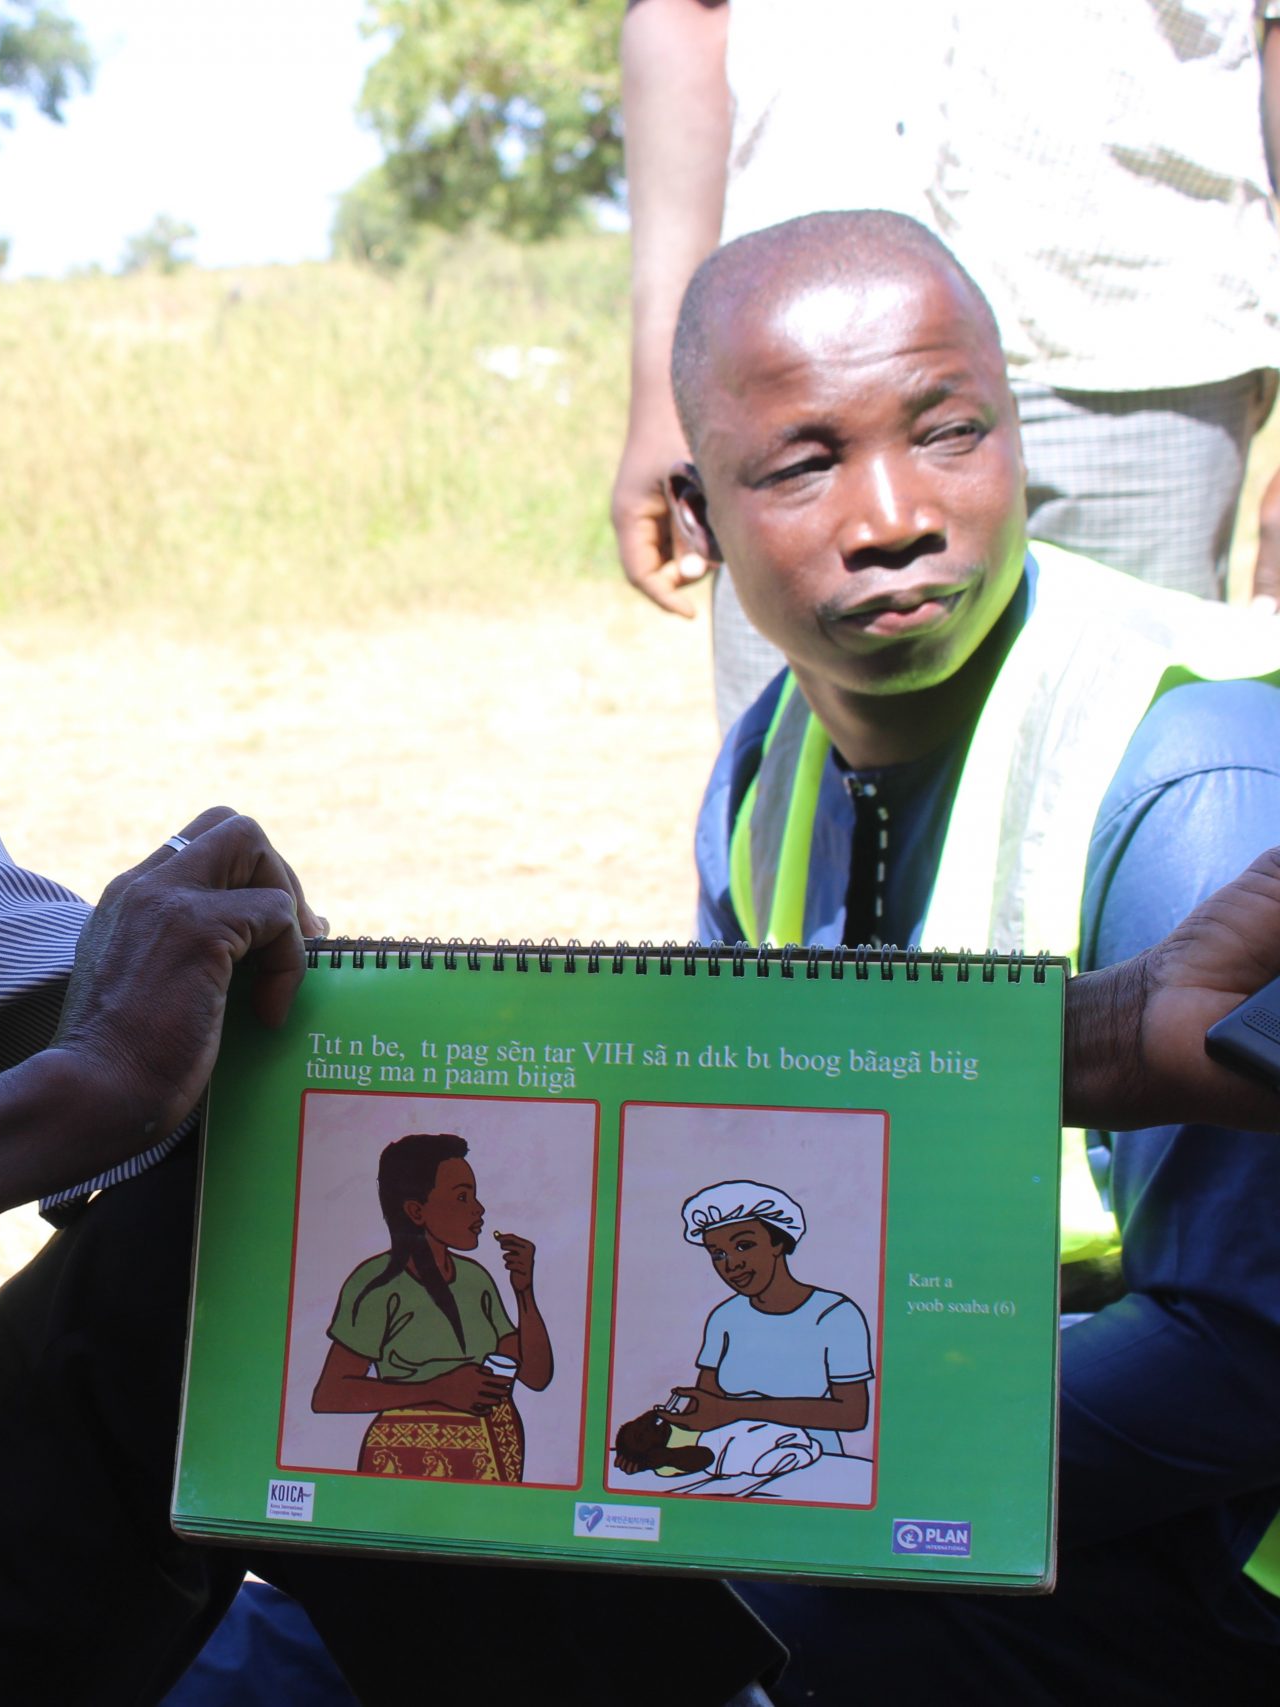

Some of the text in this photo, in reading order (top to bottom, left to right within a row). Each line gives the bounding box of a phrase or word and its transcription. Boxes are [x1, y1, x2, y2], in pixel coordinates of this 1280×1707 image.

[350, 1040, 364, 1055] n
[372, 1035, 405, 1061] be,
[445, 1043, 489, 1066] pag
[496, 1040, 536, 1062] sẽn
[544, 1045, 576, 1063] tar
[583, 1042, 635, 1065] VIH
[642, 1044, 667, 1066] sã
[676, 1051, 690, 1067] n
[779, 1047, 841, 1077] boog
[849, 1048, 922, 1079] bãagã
[929, 1050, 979, 1080] biig
[306, 1058, 577, 1094] tũnug ma n paam biigã
[908, 1273, 953, 1288] Kart a
[907, 1298, 1016, 1318] yoob soaba (6)
[271, 1484, 304, 1504] KOICA
[925, 1528, 968, 1544] PLAN
